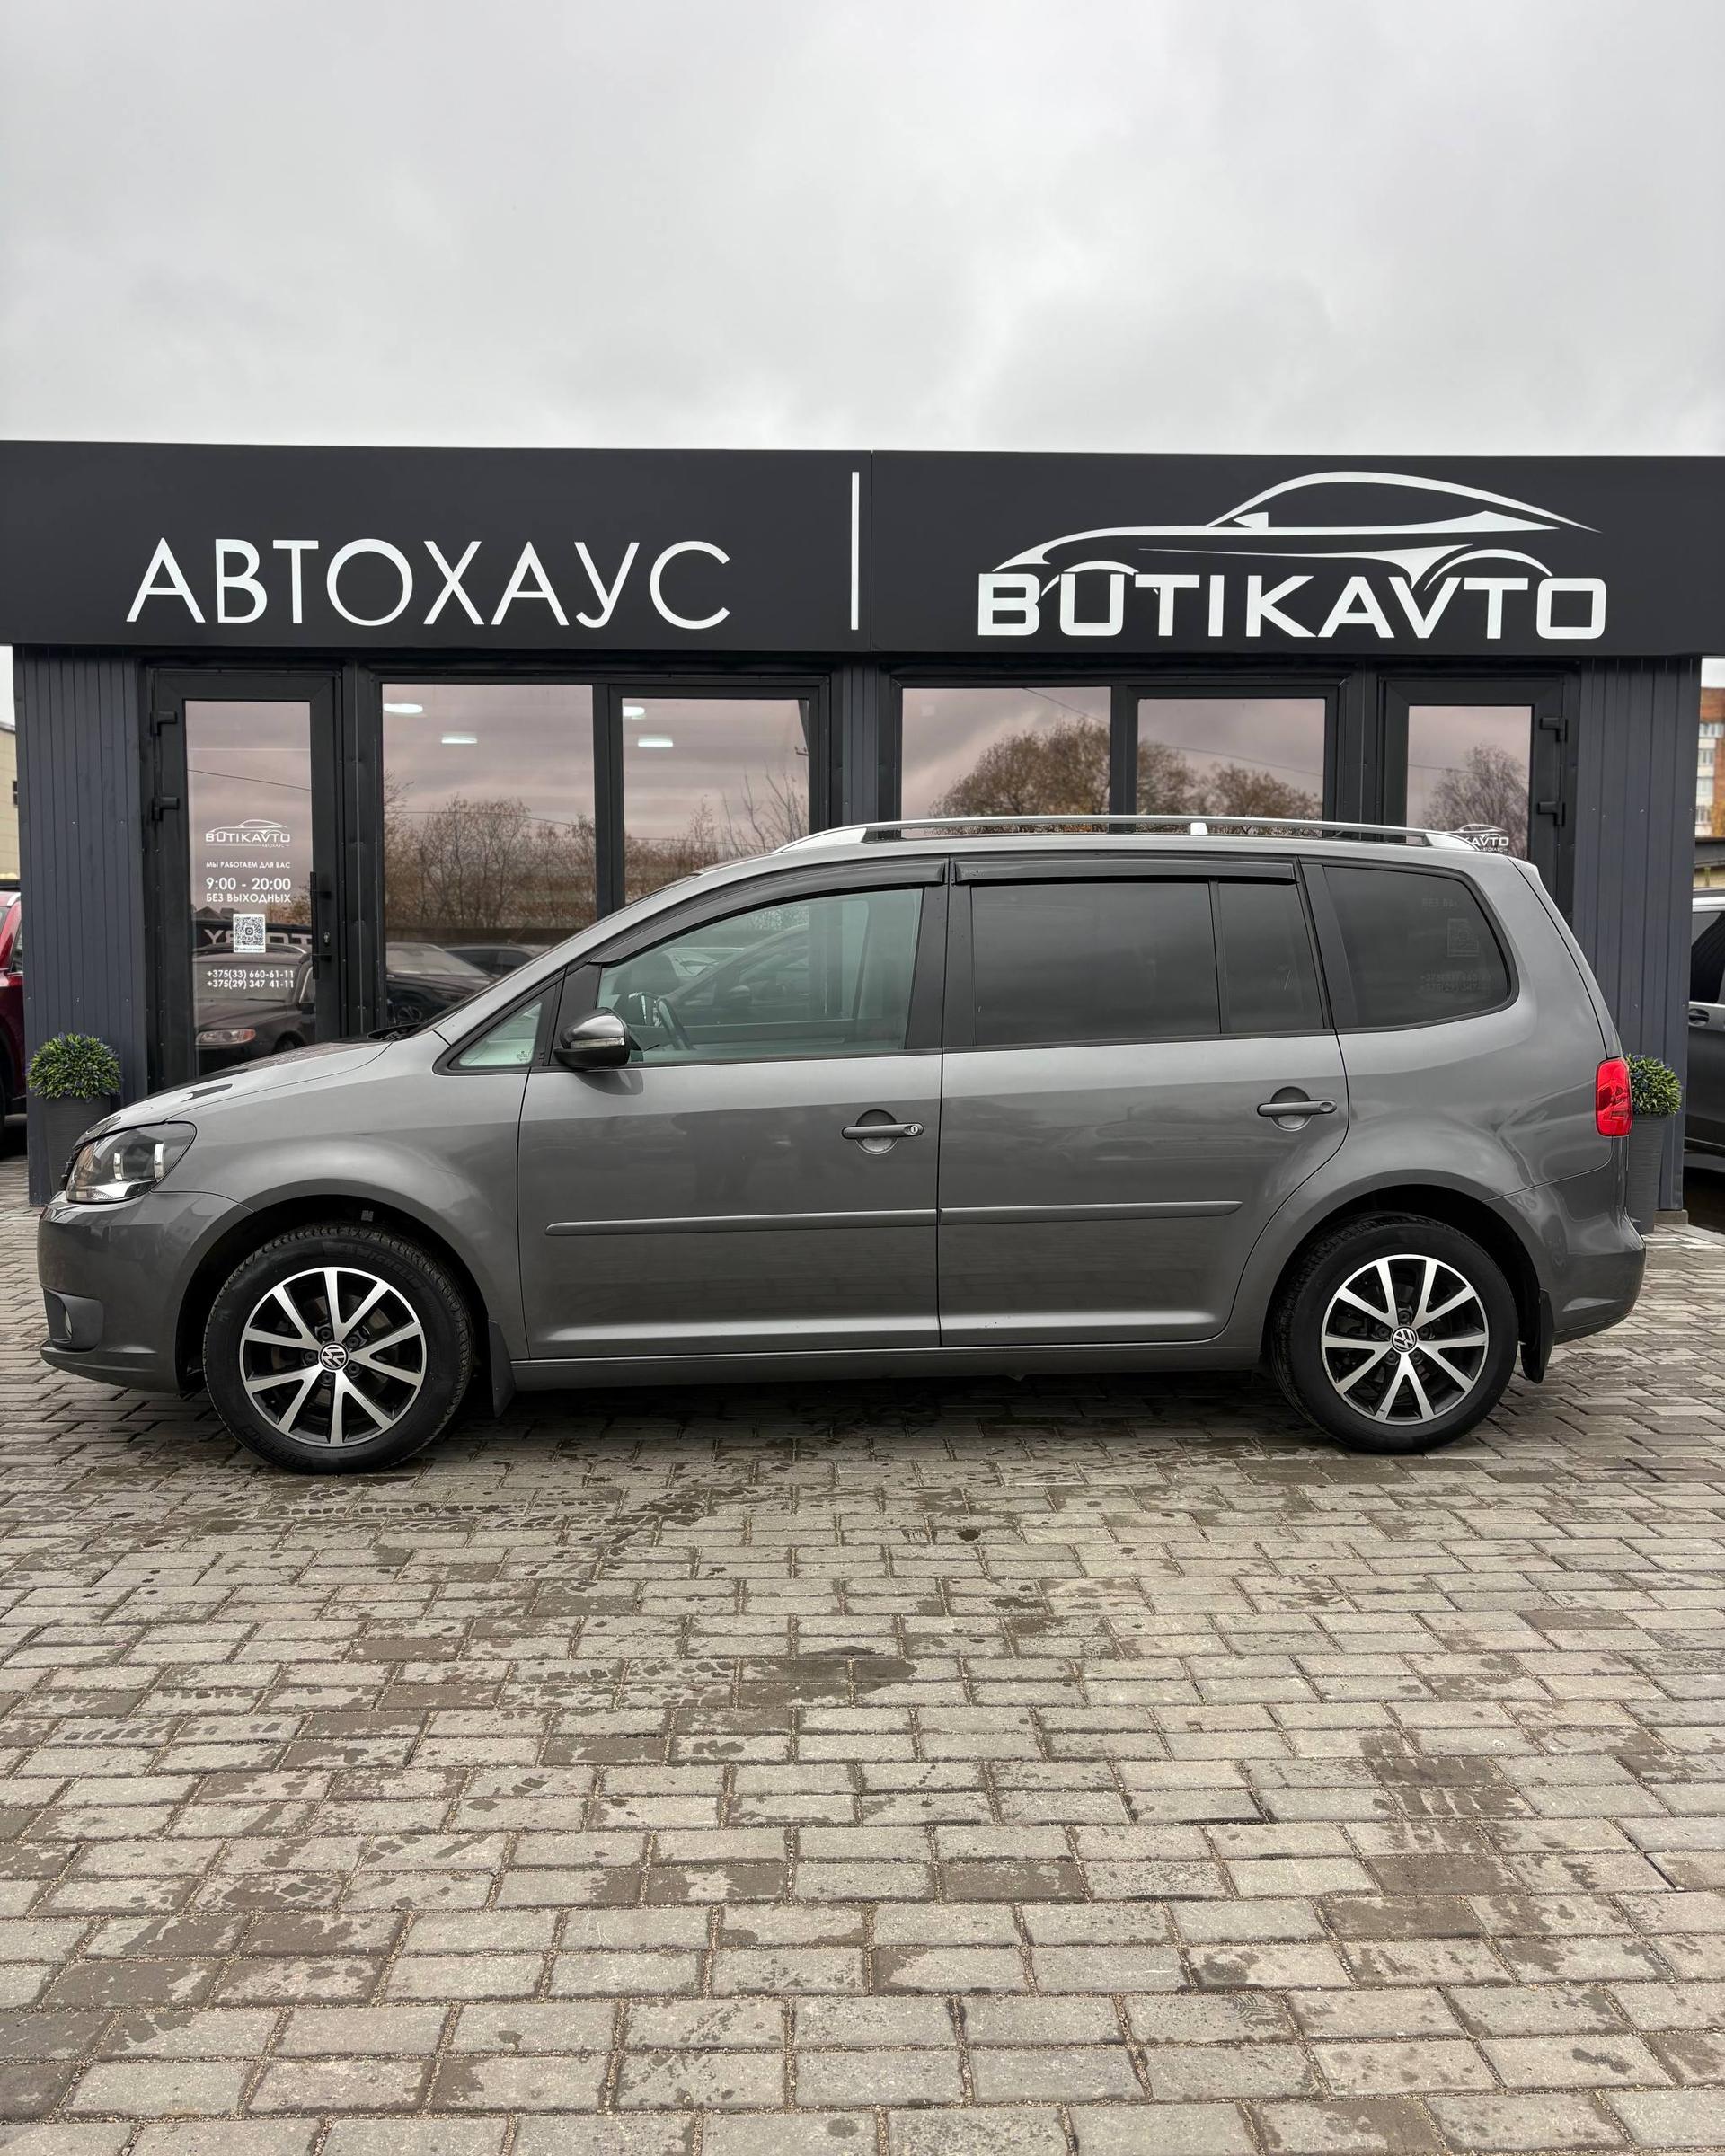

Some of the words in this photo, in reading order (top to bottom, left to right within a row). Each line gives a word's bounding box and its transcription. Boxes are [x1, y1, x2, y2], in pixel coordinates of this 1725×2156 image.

[126, 536, 731, 631] АВТОХАУС
[977, 572, 1608, 640] BUTIKAVTO
[205, 832, 291, 843] BUTIKAVTO
[259, 862, 274, 870] ДЛЯ
[275, 862, 291, 870] ВАС
[206, 877, 237, 890] 9:00
[251, 877, 291, 891] 20:00
[206, 892, 225, 903] БЕЗ
[226, 892, 292, 904] ВЫХОДНЫХ
[206, 969, 247, 980] +375(33)
[249, 969, 295, 978] 660-61-11
[206, 979, 247, 990] +375(29)
[249, 979, 266, 988] 347
[269, 979, 295, 988] 41-11
